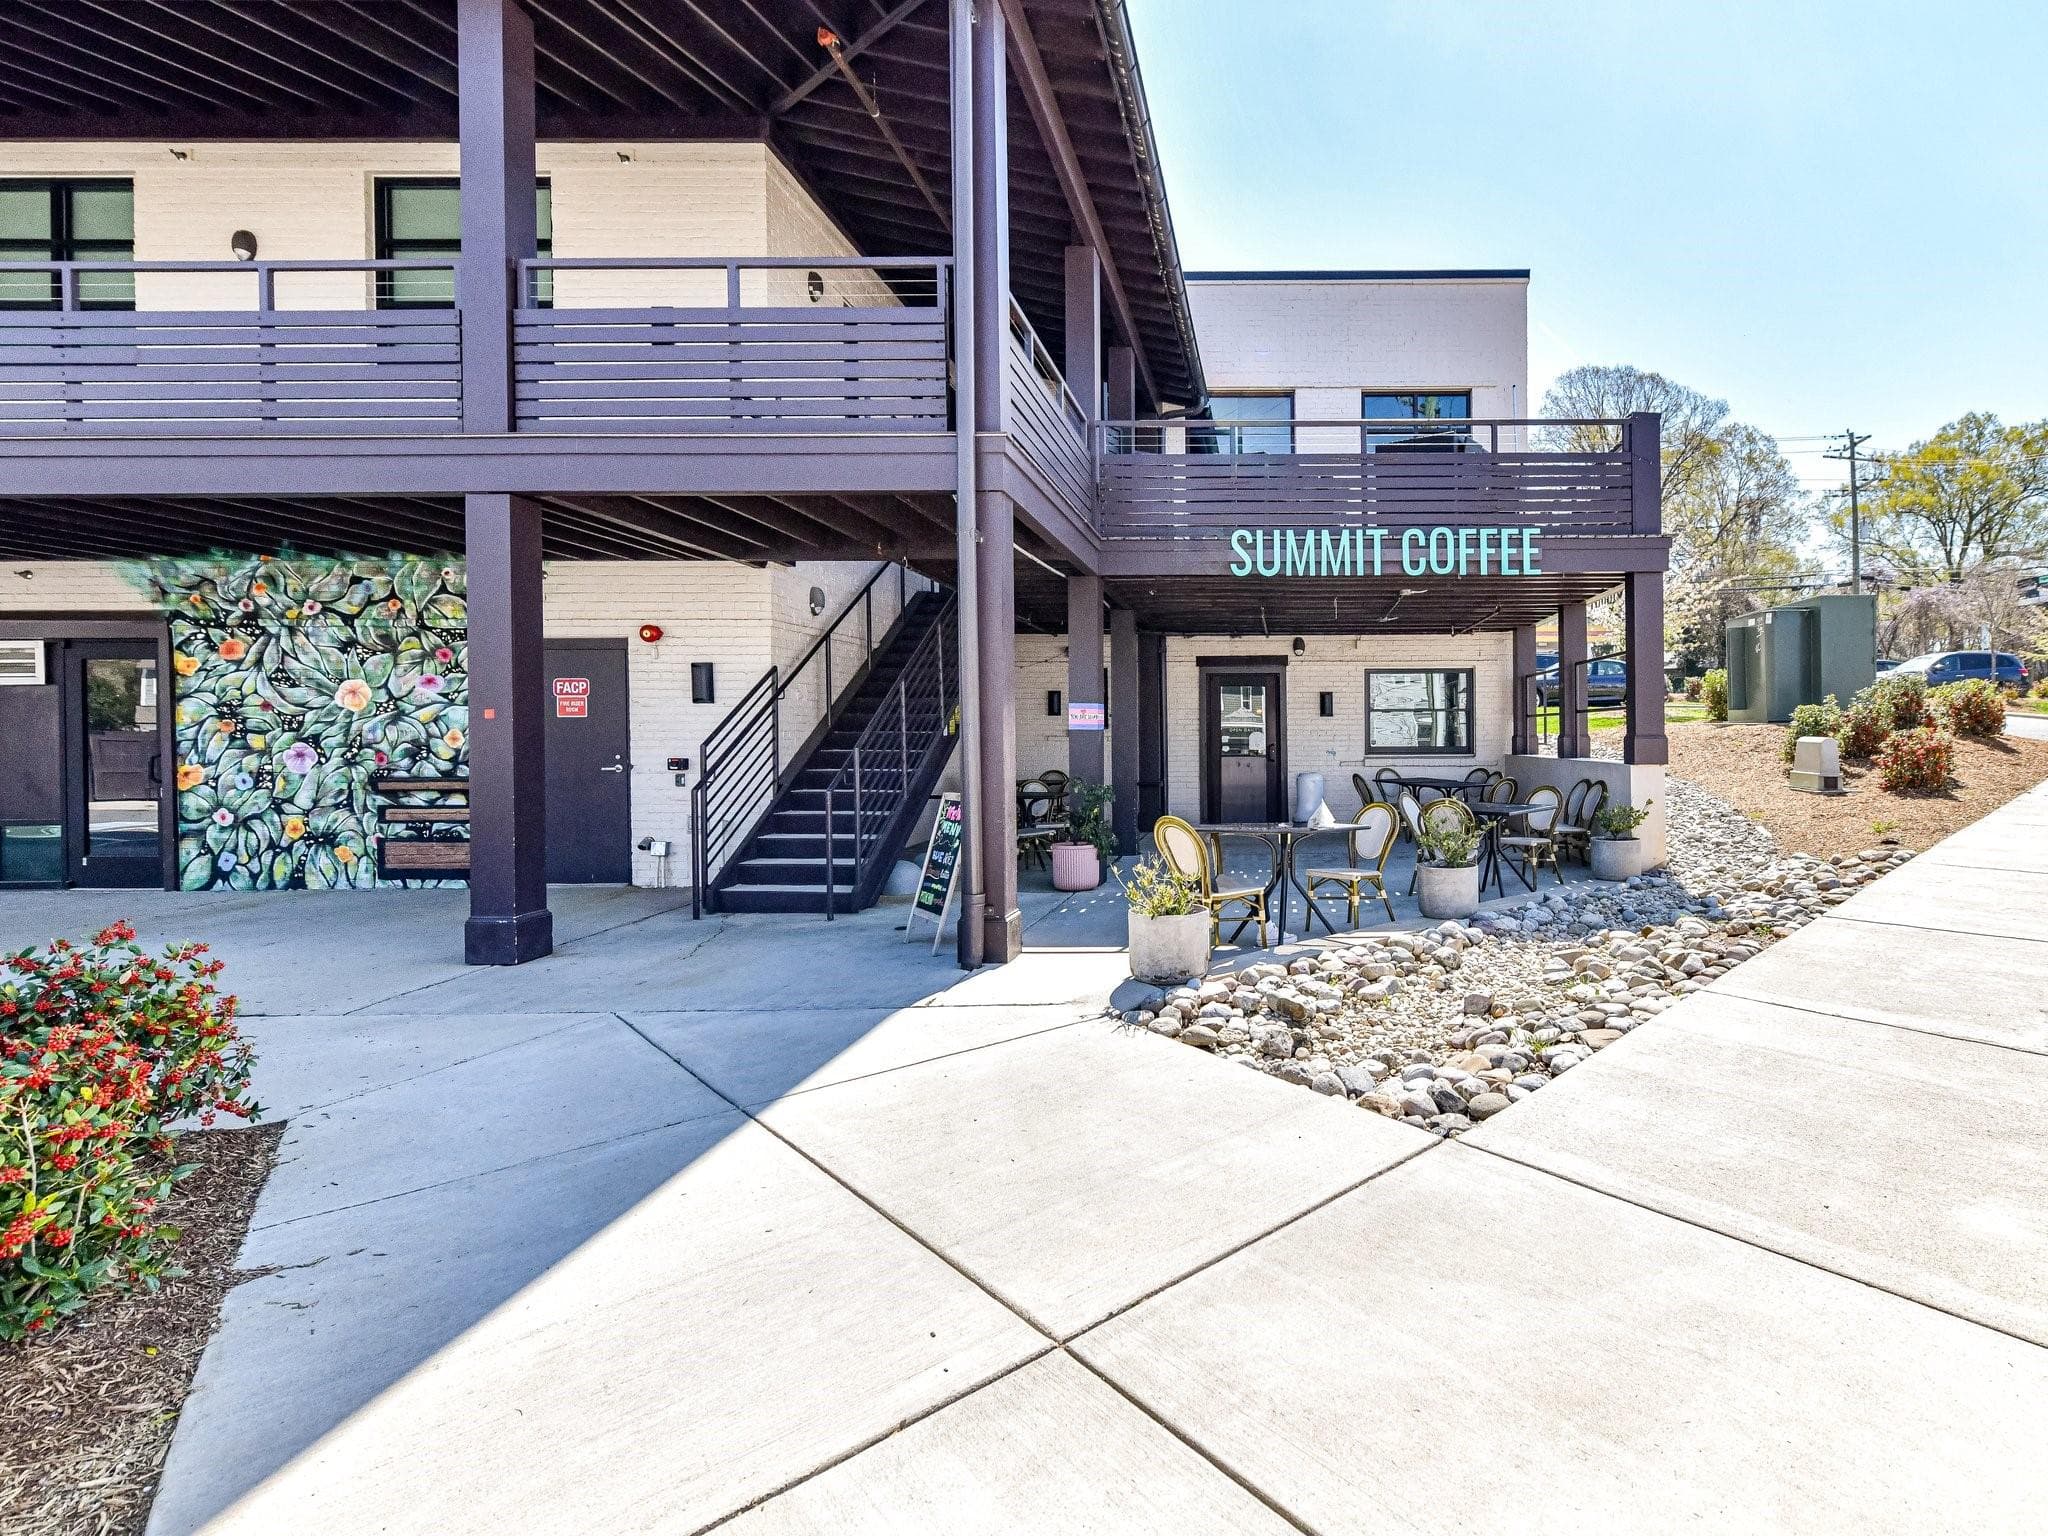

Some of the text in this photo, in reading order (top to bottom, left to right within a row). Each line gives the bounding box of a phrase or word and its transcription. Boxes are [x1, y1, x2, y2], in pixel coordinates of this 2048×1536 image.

[1230, 527, 1542, 576] SUMMIT COFFEE
[556, 681, 587, 694] FACP
